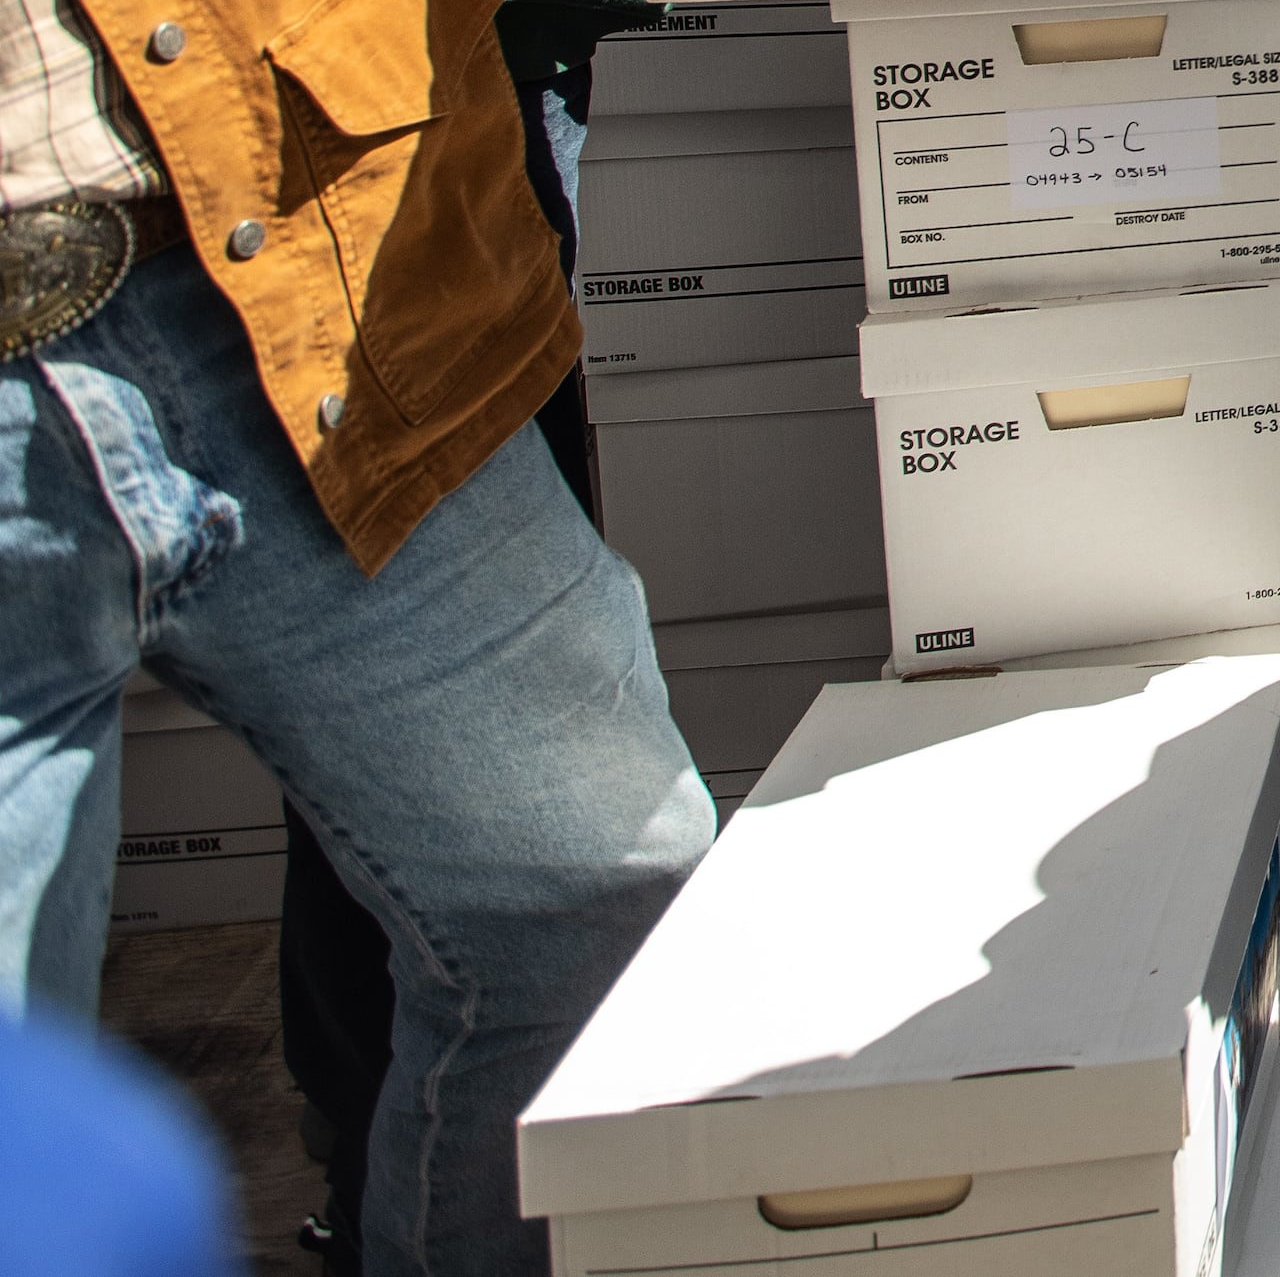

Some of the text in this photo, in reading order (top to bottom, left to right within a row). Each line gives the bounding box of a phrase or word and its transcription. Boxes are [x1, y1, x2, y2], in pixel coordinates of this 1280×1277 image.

[873, 58, 995, 86] STORAGE
[1172, 53, 1260, 71] LETTER/LEGAL
[876, 88, 932, 111] BOX
[895, 153, 949, 166] CONTENTS
[898, 194, 929, 205] FROM
[1116, 212, 1186, 226] DESTROY DATE
[901, 232, 945, 244] BOX NO.
[583, 275, 704, 297] STORAGE BOX
[892, 277, 946, 296] ULINE
[609, 353, 637, 362] 13715
[1194, 403, 1280, 423] LETTER/LEGAL
[900, 420, 1020, 451] STORAGE
[902, 450, 957, 475] BOX
[918, 630, 972, 651] ULINE
[116, 837, 222, 858] TORAGE BOX
